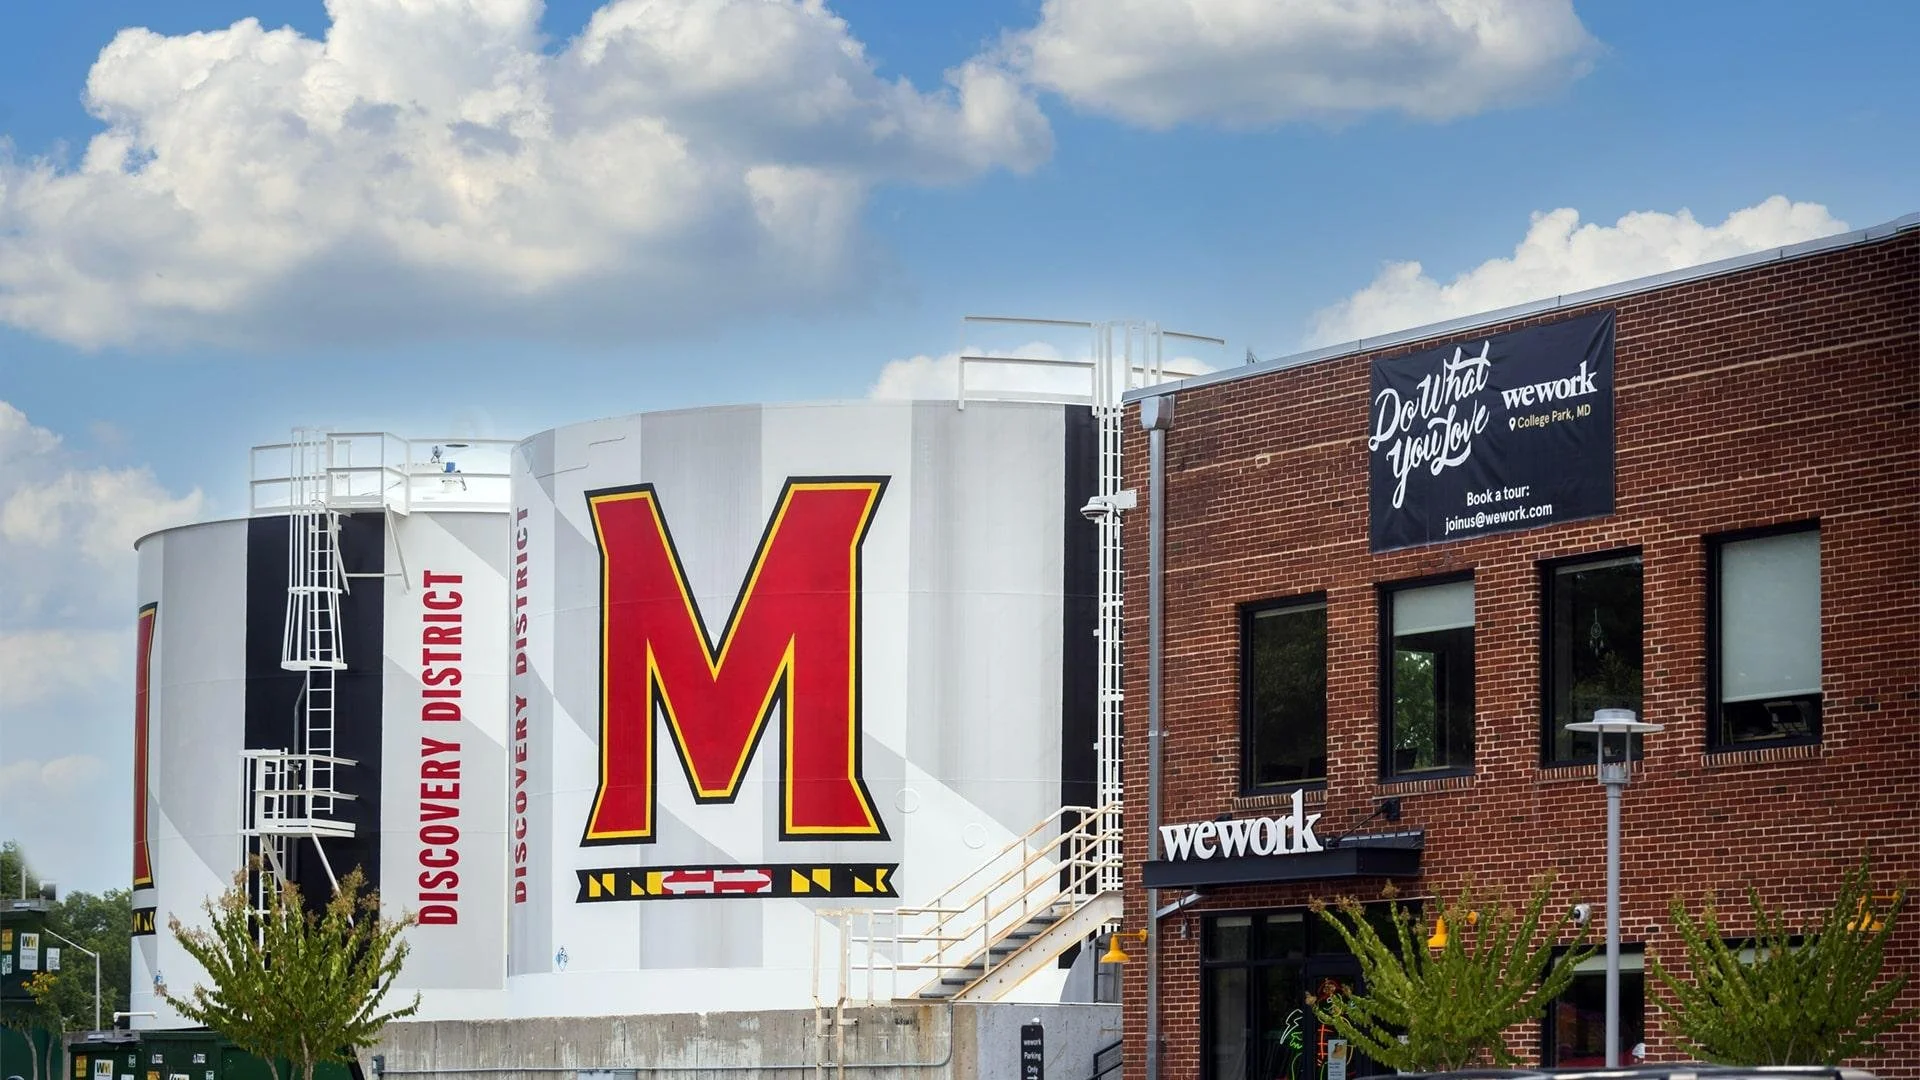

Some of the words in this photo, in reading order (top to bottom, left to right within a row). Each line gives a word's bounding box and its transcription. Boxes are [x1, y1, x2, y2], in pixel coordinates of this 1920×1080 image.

[1368, 387, 1418, 451] Do
[1416, 340, 1491, 420] What
[1501, 360, 1598, 410] wework
[1517, 414, 1550, 428] College
[1552, 407, 1575, 422] Park,
[1576, 403, 1591, 417] MD
[1386, 428, 1442, 508] You
[1427, 400, 1490, 476] Love
[1445, 504, 1553, 535] joinus@wework.com
[1467, 488, 1493, 506] Book
[1495, 490, 1501, 501] a
[1503, 485, 1530, 500] tour:
[515, 507, 530, 676] DISTRICT
[421, 570, 465, 722] DISTRICT
[418, 736, 462, 925] DISCOVERY
[515, 695, 529, 904] DISCOVERY
[1159, 788, 1324, 862] wework
[1023, 1038, 1042, 1046] wework
[1023, 1051, 1042, 1062] Parking
[1027, 1065, 1039, 1075] Only
